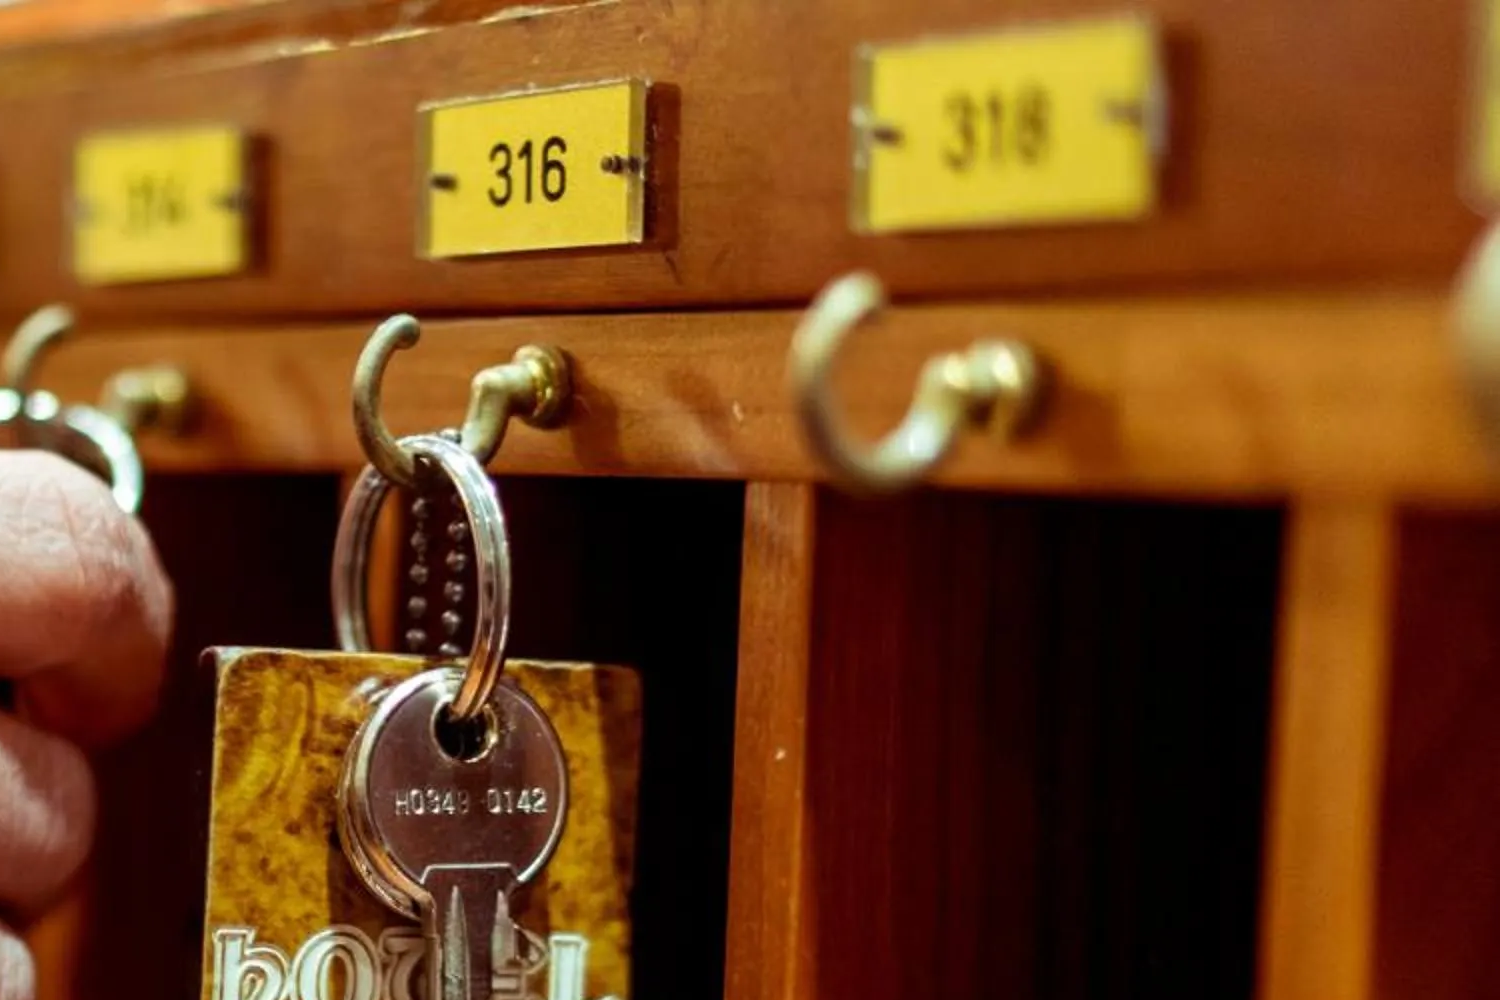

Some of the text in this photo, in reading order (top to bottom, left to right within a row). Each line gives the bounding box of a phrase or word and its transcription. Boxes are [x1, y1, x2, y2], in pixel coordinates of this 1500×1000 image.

[941, 84, 1055, 174] 318
[487, 135, 567, 208] 316
[485, 786, 548, 815] 0142
